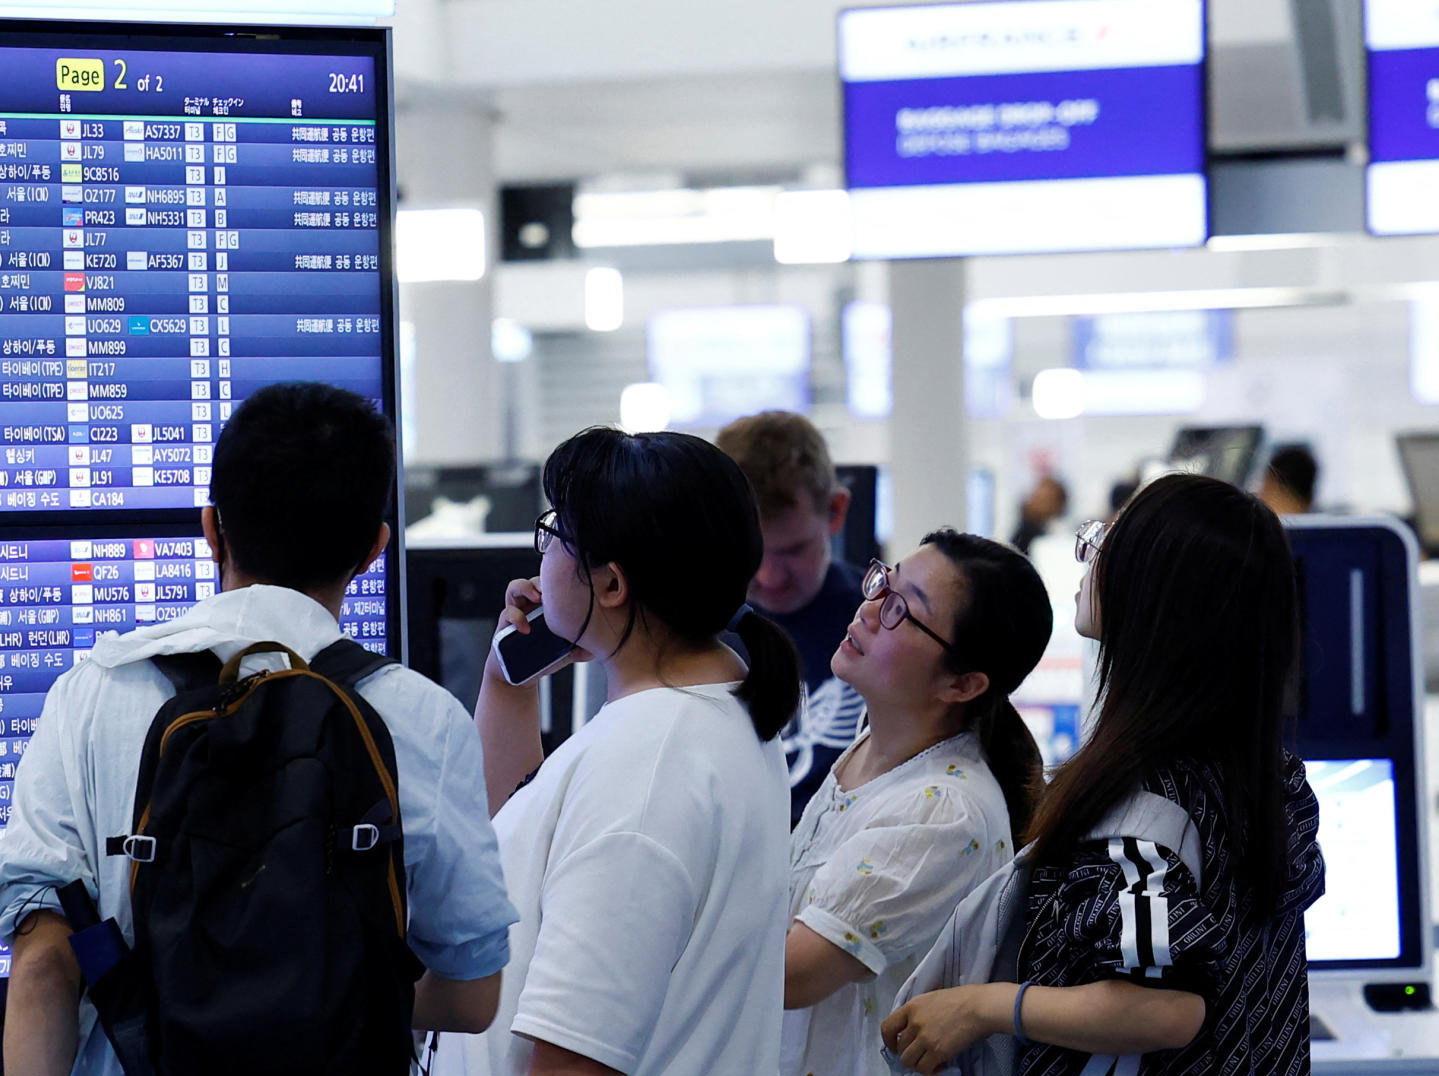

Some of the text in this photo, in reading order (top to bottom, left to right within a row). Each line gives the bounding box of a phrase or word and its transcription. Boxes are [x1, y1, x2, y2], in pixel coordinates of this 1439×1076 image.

[61, 65, 100, 86] Page
[114, 59, 127, 89] 2
[137, 75, 149, 91] of
[155, 76, 163, 92] 2
[329, 73, 364, 93] 20:41
[82, 124, 104, 137] JL33
[145, 125, 181, 138] AS7337
[189, 127, 200, 138] T3
[216, 126, 222, 138] F
[227, 126, 234, 138] G
[83, 146, 105, 159] JL79
[146, 147, 183, 160] HA5011
[83, 167, 120, 181] 9C8516
[84, 189, 116, 202] OZ177
[147, 190, 185, 203] NH6895
[85, 211, 116, 224] PR423
[148, 212, 185, 225] NH5331
[85, 233, 107, 245] JL77
[86, 255, 117, 267] KE720
[148, 255, 184, 268] AF5367
[86, 276, 115, 289] VJ821
[87, 298, 125, 311] MM809
[87, 319, 121, 332] UO629
[150, 320, 186, 332] CX5629
[88, 341, 126, 354] MM899
[89, 363, 116, 376] IT217
[89, 384, 128, 397] MM859
[90, 406, 124, 419] UO625
[91, 428, 118, 441] CI223
[152, 427, 185, 440] JL5041
[91, 449, 113, 463] JL47
[154, 448, 191, 461] AY5072
[91, 471, 113, 484] JL91
[154, 470, 190, 483] KE5708
[92, 492, 124, 505] CA184
[93, 544, 126, 557] NH889
[155, 542, 193, 556] VA7403
[93, 565, 119, 580] QF26
[156, 564, 192, 577] LA8416
[94, 587, 130, 600] MU576
[156, 585, 188, 599] JL5791
[95, 609, 127, 622] NH861
